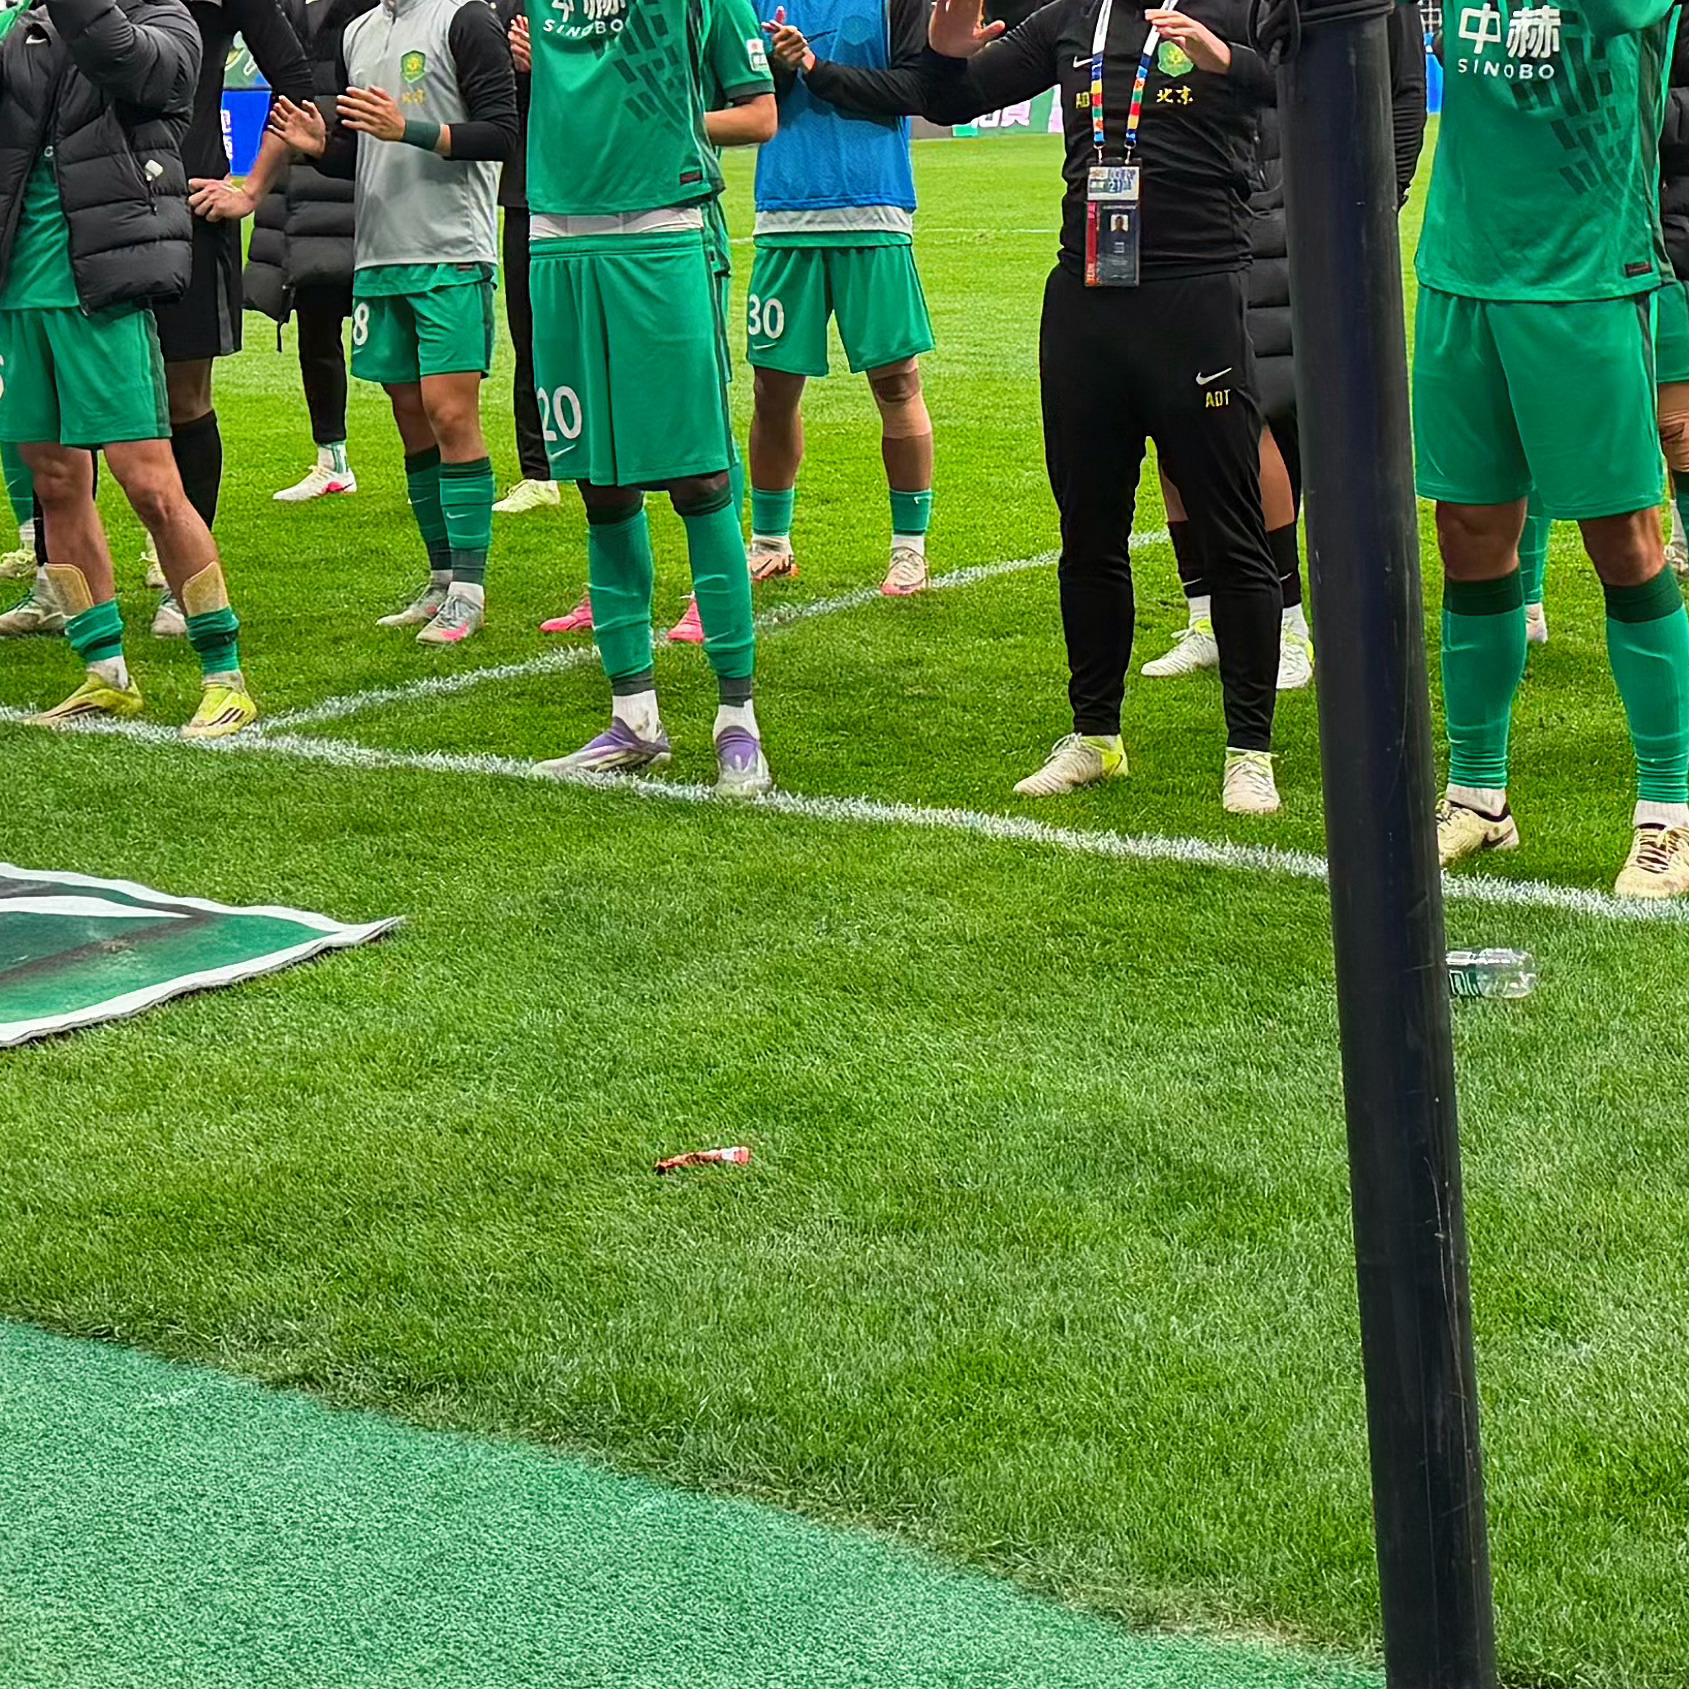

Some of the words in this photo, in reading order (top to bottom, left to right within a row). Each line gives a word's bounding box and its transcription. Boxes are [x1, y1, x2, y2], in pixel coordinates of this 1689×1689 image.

[543, 18, 624, 37] SINOBO
[1458, 3, 1562, 59] 中赫
[1458, 57, 1555, 80] SINOBO
[748, 292, 790, 340] 30
[537, 384, 583, 441] 20
[1205, 388, 1231, 408] ADT
